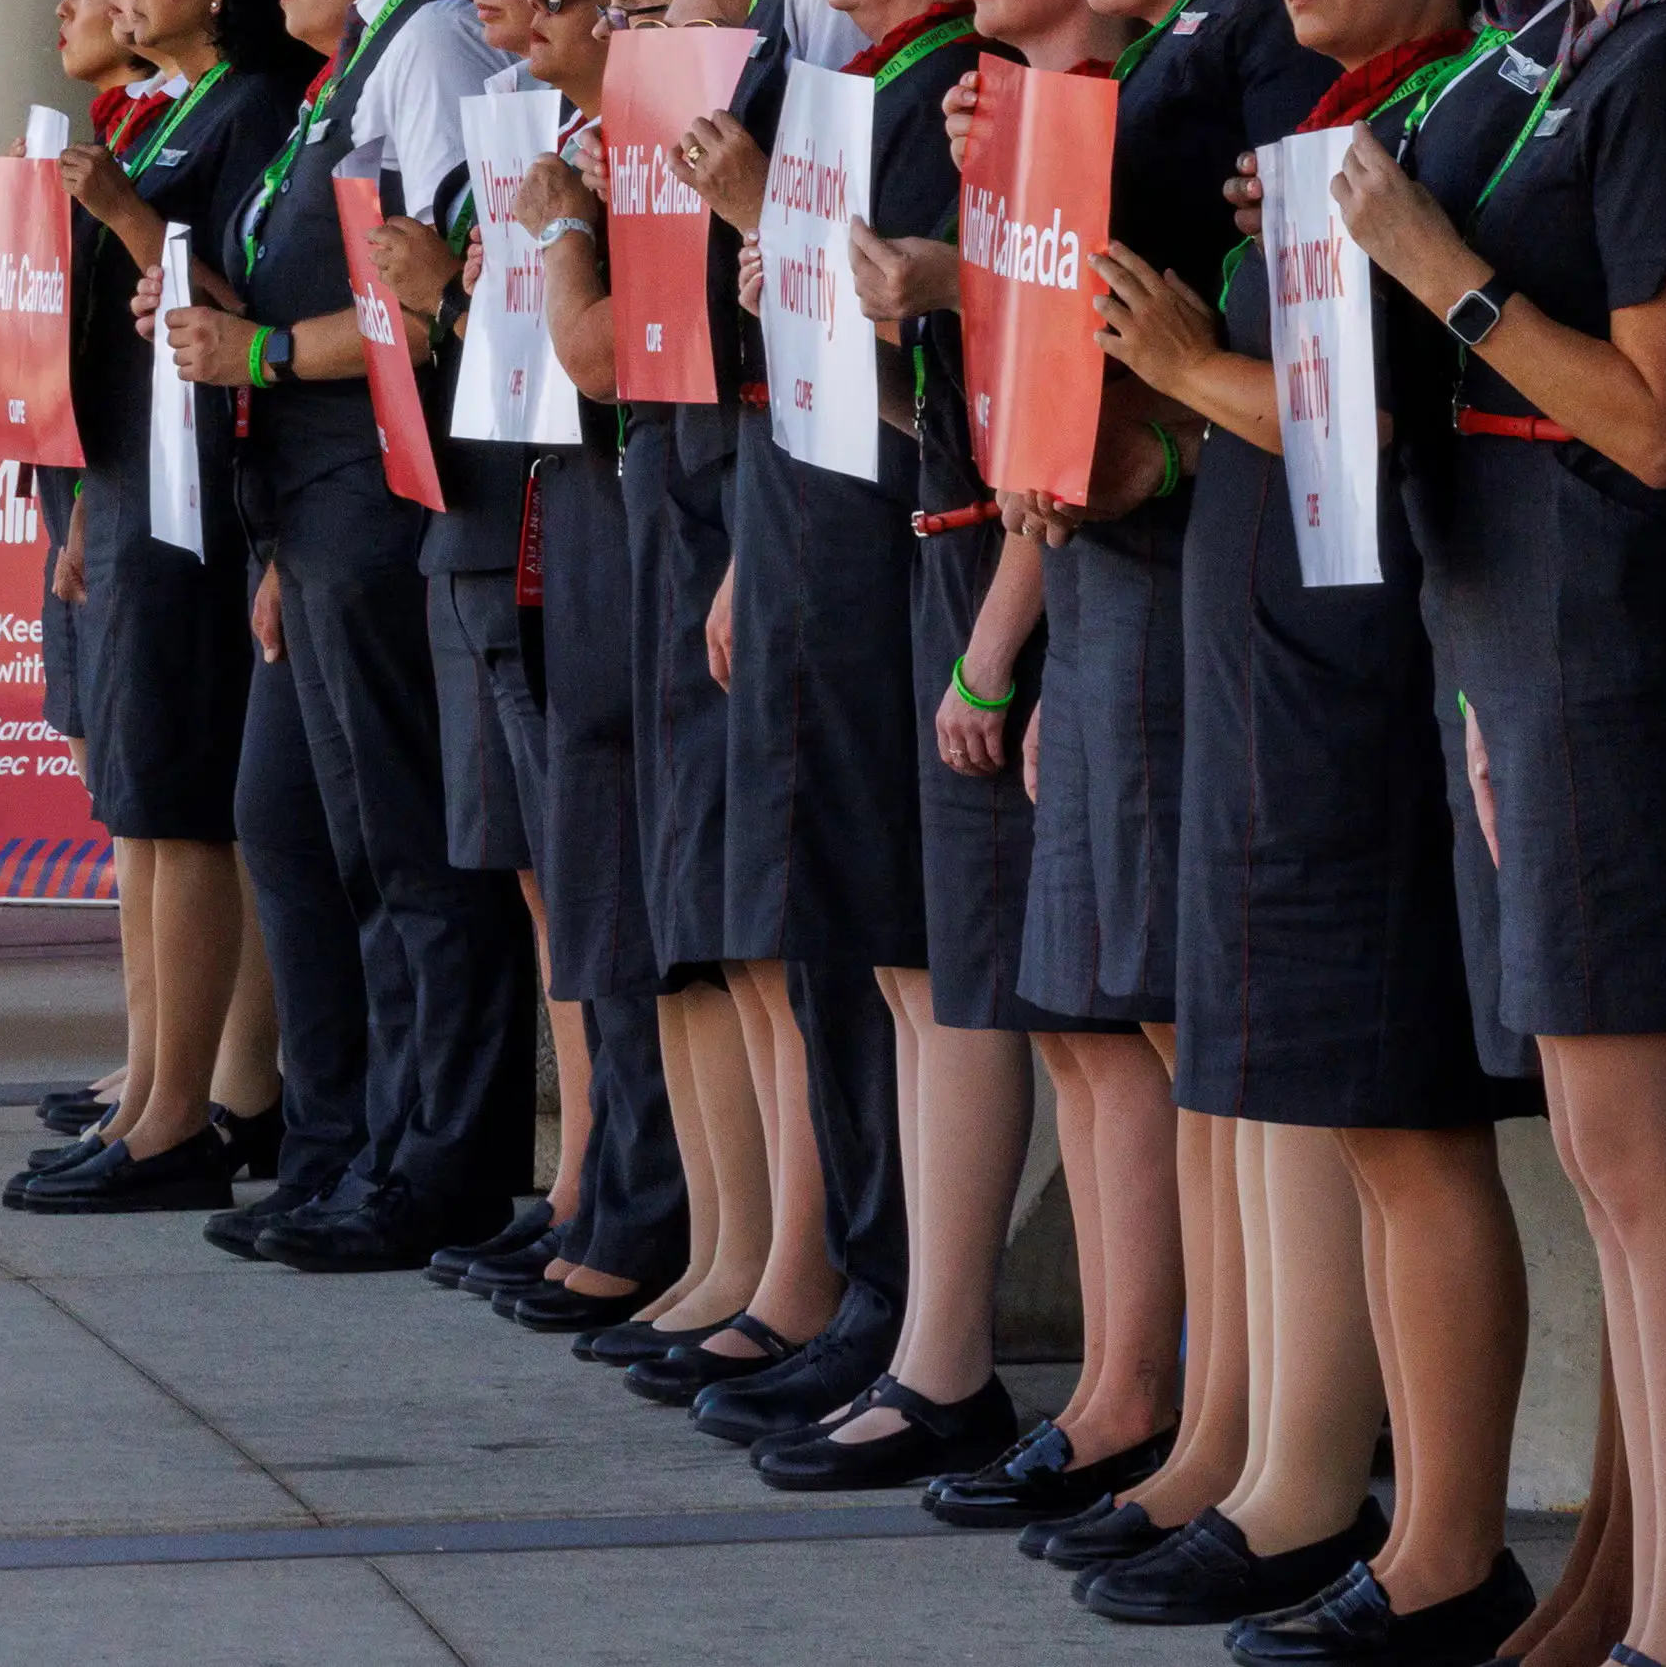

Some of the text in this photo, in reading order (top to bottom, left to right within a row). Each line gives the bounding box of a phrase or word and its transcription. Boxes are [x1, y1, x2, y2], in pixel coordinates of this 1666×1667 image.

[1385, 64, 1440, 107] ontract
[608, 144, 649, 216] UnfAir
[771, 132, 848, 226] Unpaid work
[962, 183, 1080, 291] UnfAir Canada
[1301, 215, 1345, 301] work
[18, 254, 65, 315] Canada
[780, 244, 836, 342] won't fly
[645, 323, 663, 352] CUPE
[7, 399, 26, 424] CUPE
[794, 378, 813, 412] CUPE
[38, 755, 81, 777] vou
